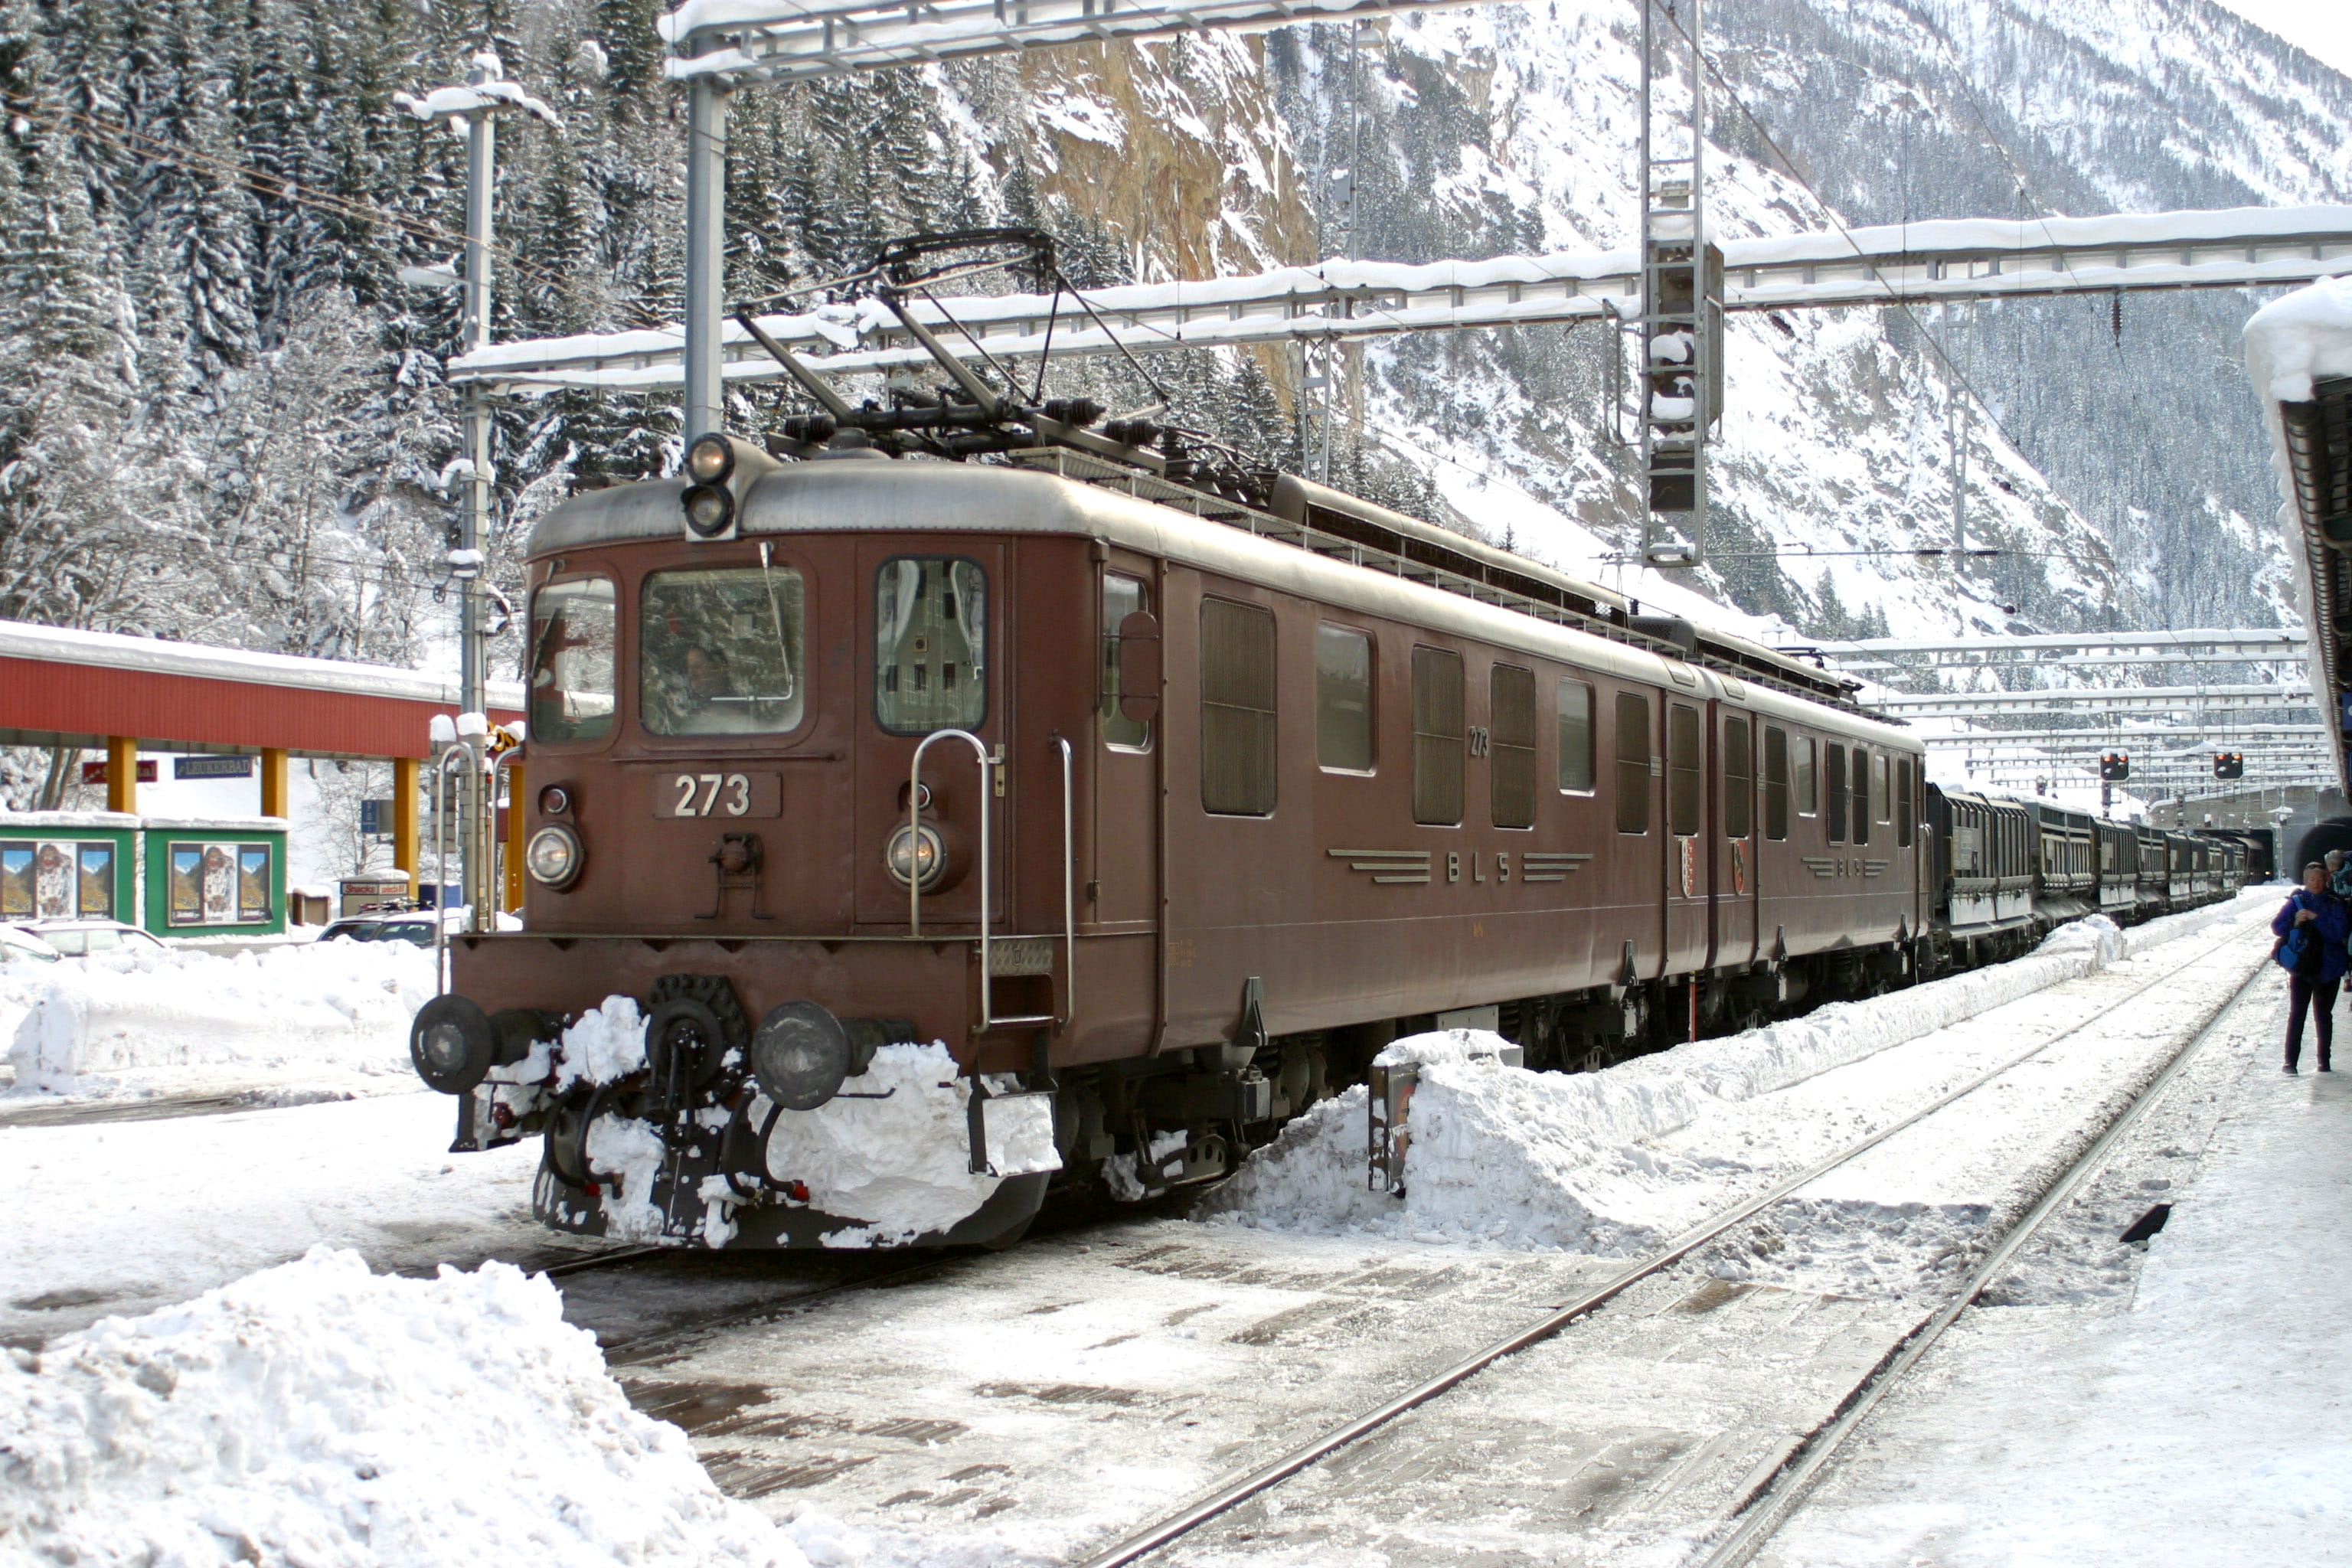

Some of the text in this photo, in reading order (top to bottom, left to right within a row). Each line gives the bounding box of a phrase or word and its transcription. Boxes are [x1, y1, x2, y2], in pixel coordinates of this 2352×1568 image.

[1468, 726, 1488, 756] 273
[185, 760, 249, 775] LEUKERBAD
[675, 773, 750, 816] 273
[1448, 851, 1510, 882] BLS
[345, 884, 374, 893] Snacks
